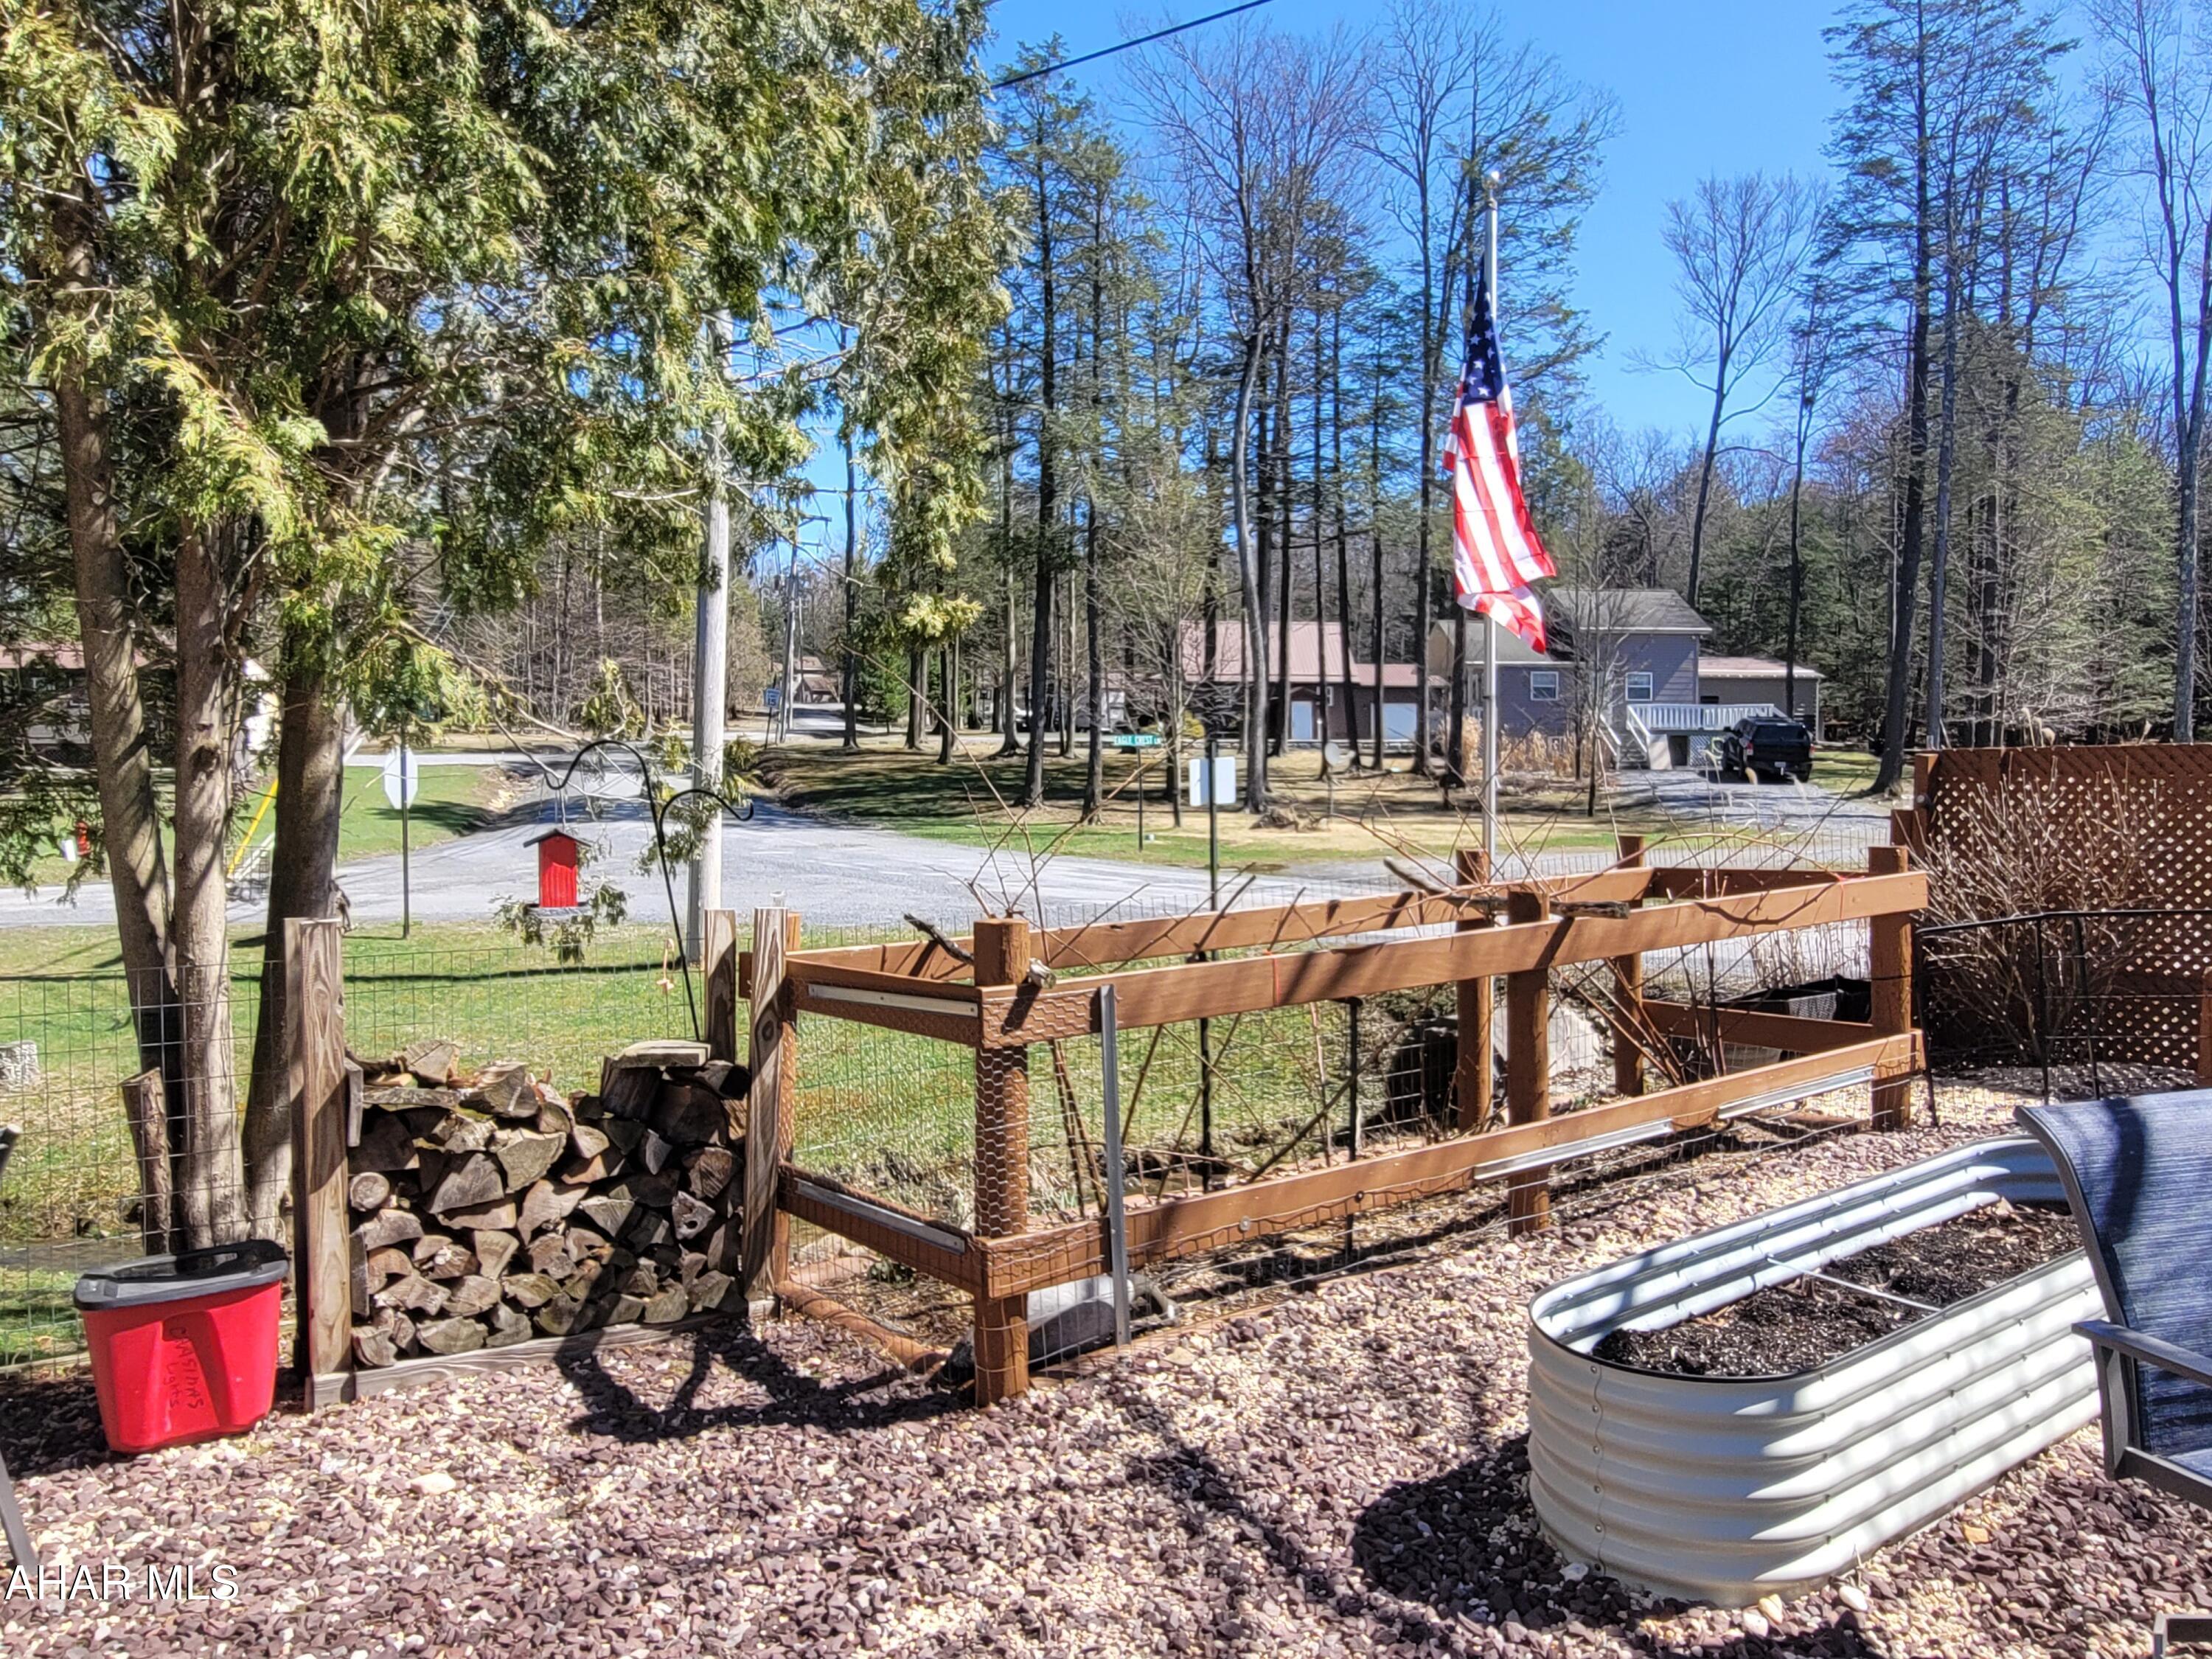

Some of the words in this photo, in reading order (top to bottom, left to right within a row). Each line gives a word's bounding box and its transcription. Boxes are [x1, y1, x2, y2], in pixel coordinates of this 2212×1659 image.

[768, 698, 776, 706] 15
[1114, 735, 1133, 746] EAGLE
[1134, 735, 1153, 746] CREST
